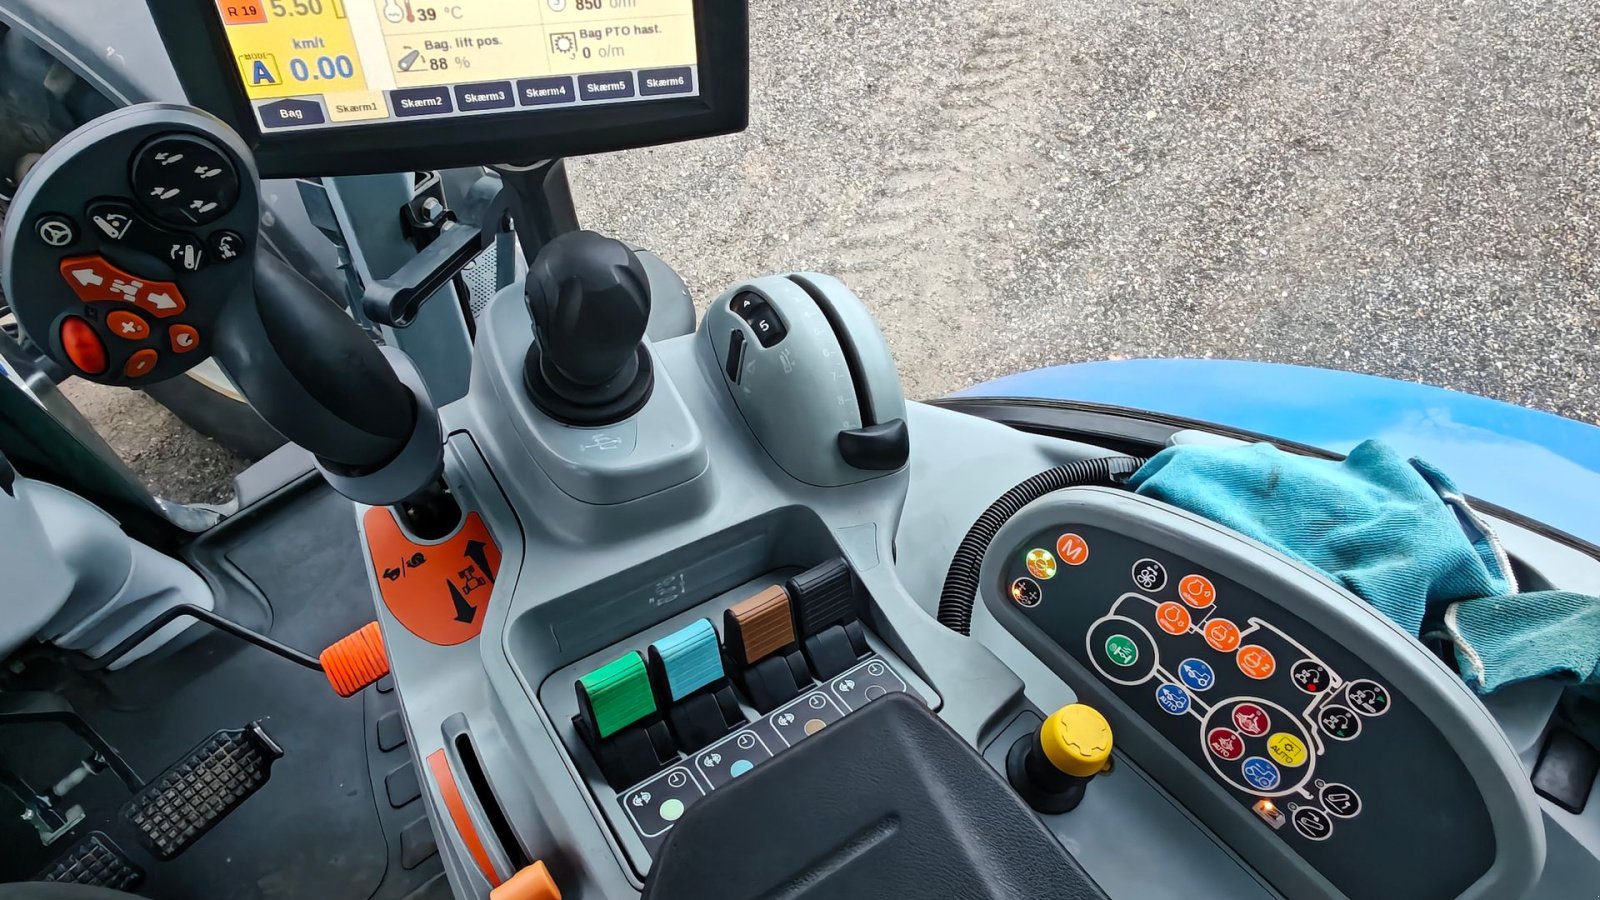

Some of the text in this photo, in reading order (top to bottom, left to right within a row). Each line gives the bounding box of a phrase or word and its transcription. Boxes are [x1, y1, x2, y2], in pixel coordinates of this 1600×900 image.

[227, 6, 257, 17] R 19
[272, 0, 323, 17] 5.50
[576, 0, 602, 10] 850
[417, 6, 464, 21] 39 °C
[580, 24, 662, 40] Bag PTO hast.
[292, 37, 325, 49] km/t
[424, 35, 503, 51] Bag. lift pos.
[582, 44, 625, 59] 0 o/m
[290, 55, 354, 82] 0.00
[430, 56, 471, 71] 88 %
[253, 60, 275, 84] A
[587, 81, 626, 93] Skærm5
[646, 76, 684, 88] Skærm6
[464, 91, 506, 103] Skærm3
[526, 85, 566, 98] Skærm4
[336, 102, 378, 113] Skærm1
[401, 96, 443, 108] Skærm2
[279, 108, 303, 119] Bag
[759, 319, 769, 332] 5
[1061, 539, 1083, 560] M
[1261, 664, 1271, 673] 2
[1159, 695, 1178, 712] AUTO
[1211, 741, 1230, 758] AUTO
[1270, 745, 1294, 764] AUTO
